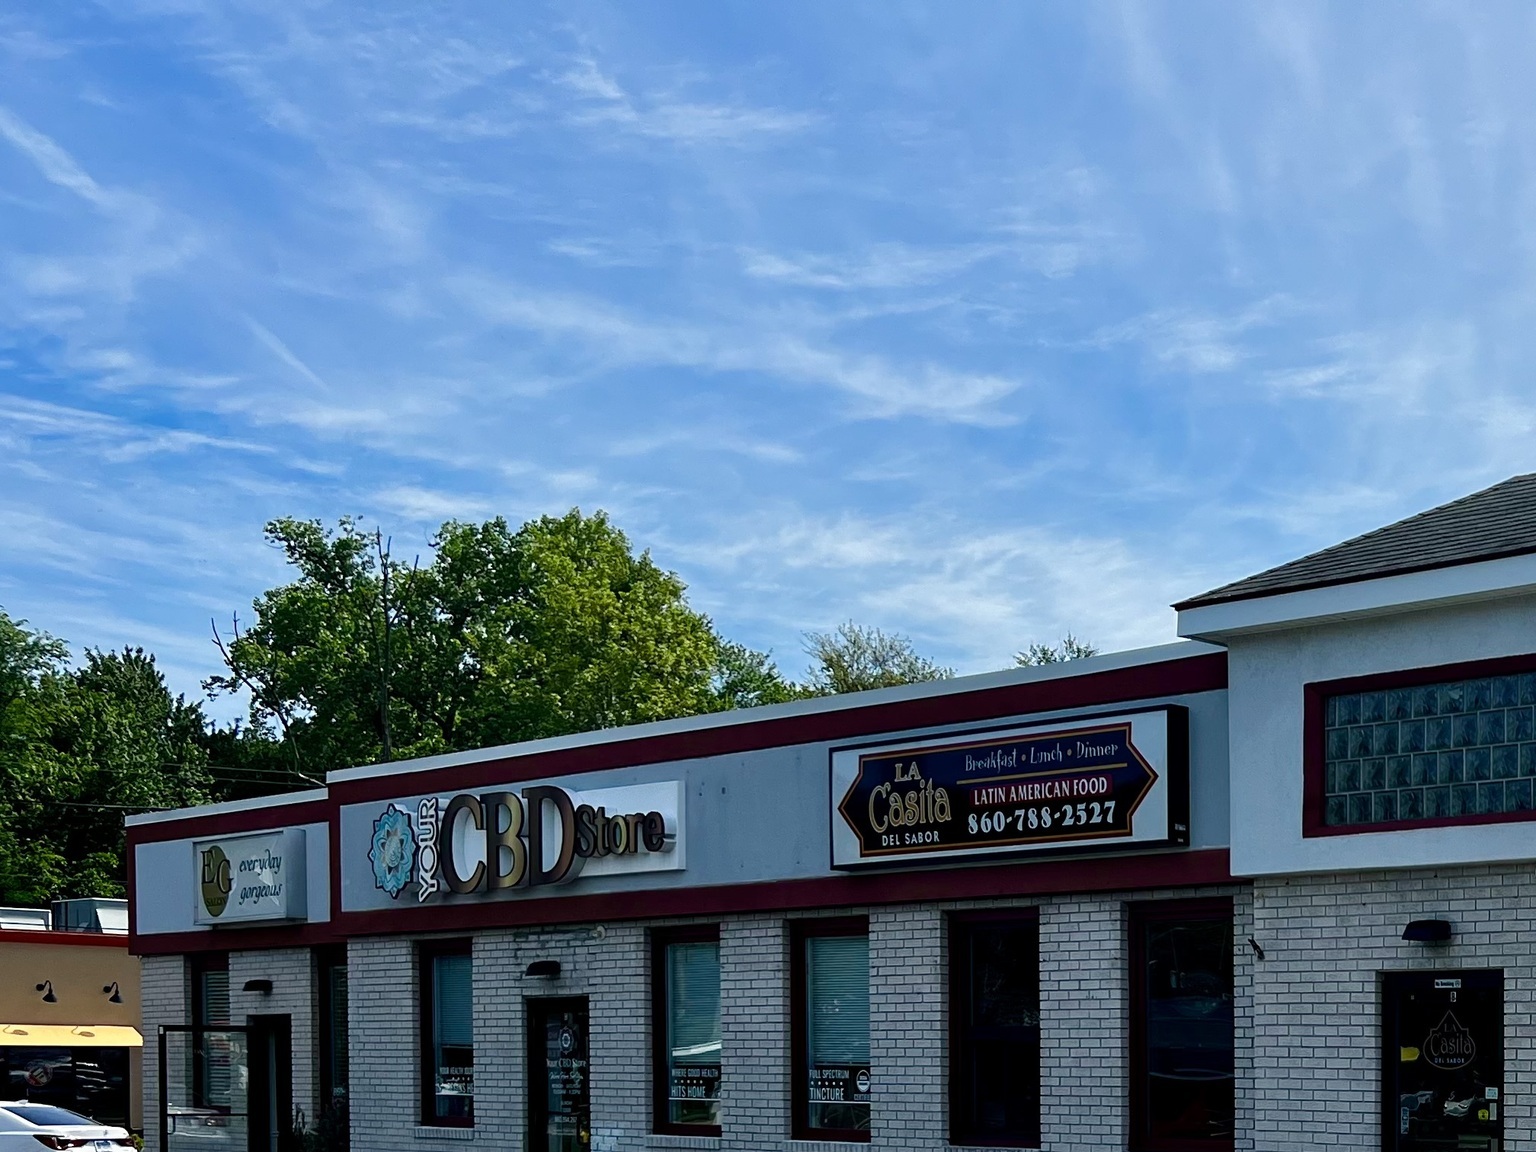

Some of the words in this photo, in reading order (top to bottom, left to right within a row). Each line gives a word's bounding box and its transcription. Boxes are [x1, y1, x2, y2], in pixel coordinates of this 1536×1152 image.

[965, 749, 1017, 773] Breakfast
[1030, 743, 1063, 764] Lunch
[1076, 741, 1118, 759] Dinner
[895, 762, 921, 782] LA
[974, 787, 1008, 805] LATIN
[1009, 780, 1070, 802] AMERICAN
[1073, 777, 1107, 796] FOOD
[869, 778, 952, 833] Casita
[968, 800, 1116, 834] 860-788-2527
[417, 797, 439, 902] YOUR
[439, 784, 575, 894] CBD
[575, 803, 666, 858] Store
[882, 834, 900, 846] DEL
[905, 831, 939, 844] SABOR
[239, 849, 282, 874] everyday
[239, 883, 283, 905] gorgeous
[1444, 1024, 1457, 1032] LA
[1430, 1032, 1472, 1056] Casita
[810, 1070, 821, 1078] FULL
[822, 1070, 849, 1078] SPECTRUM
[671, 1086, 686, 1097] HITS
[688, 1086, 706, 1098] HOME
[810, 1088, 844, 1100] TINCTURE
